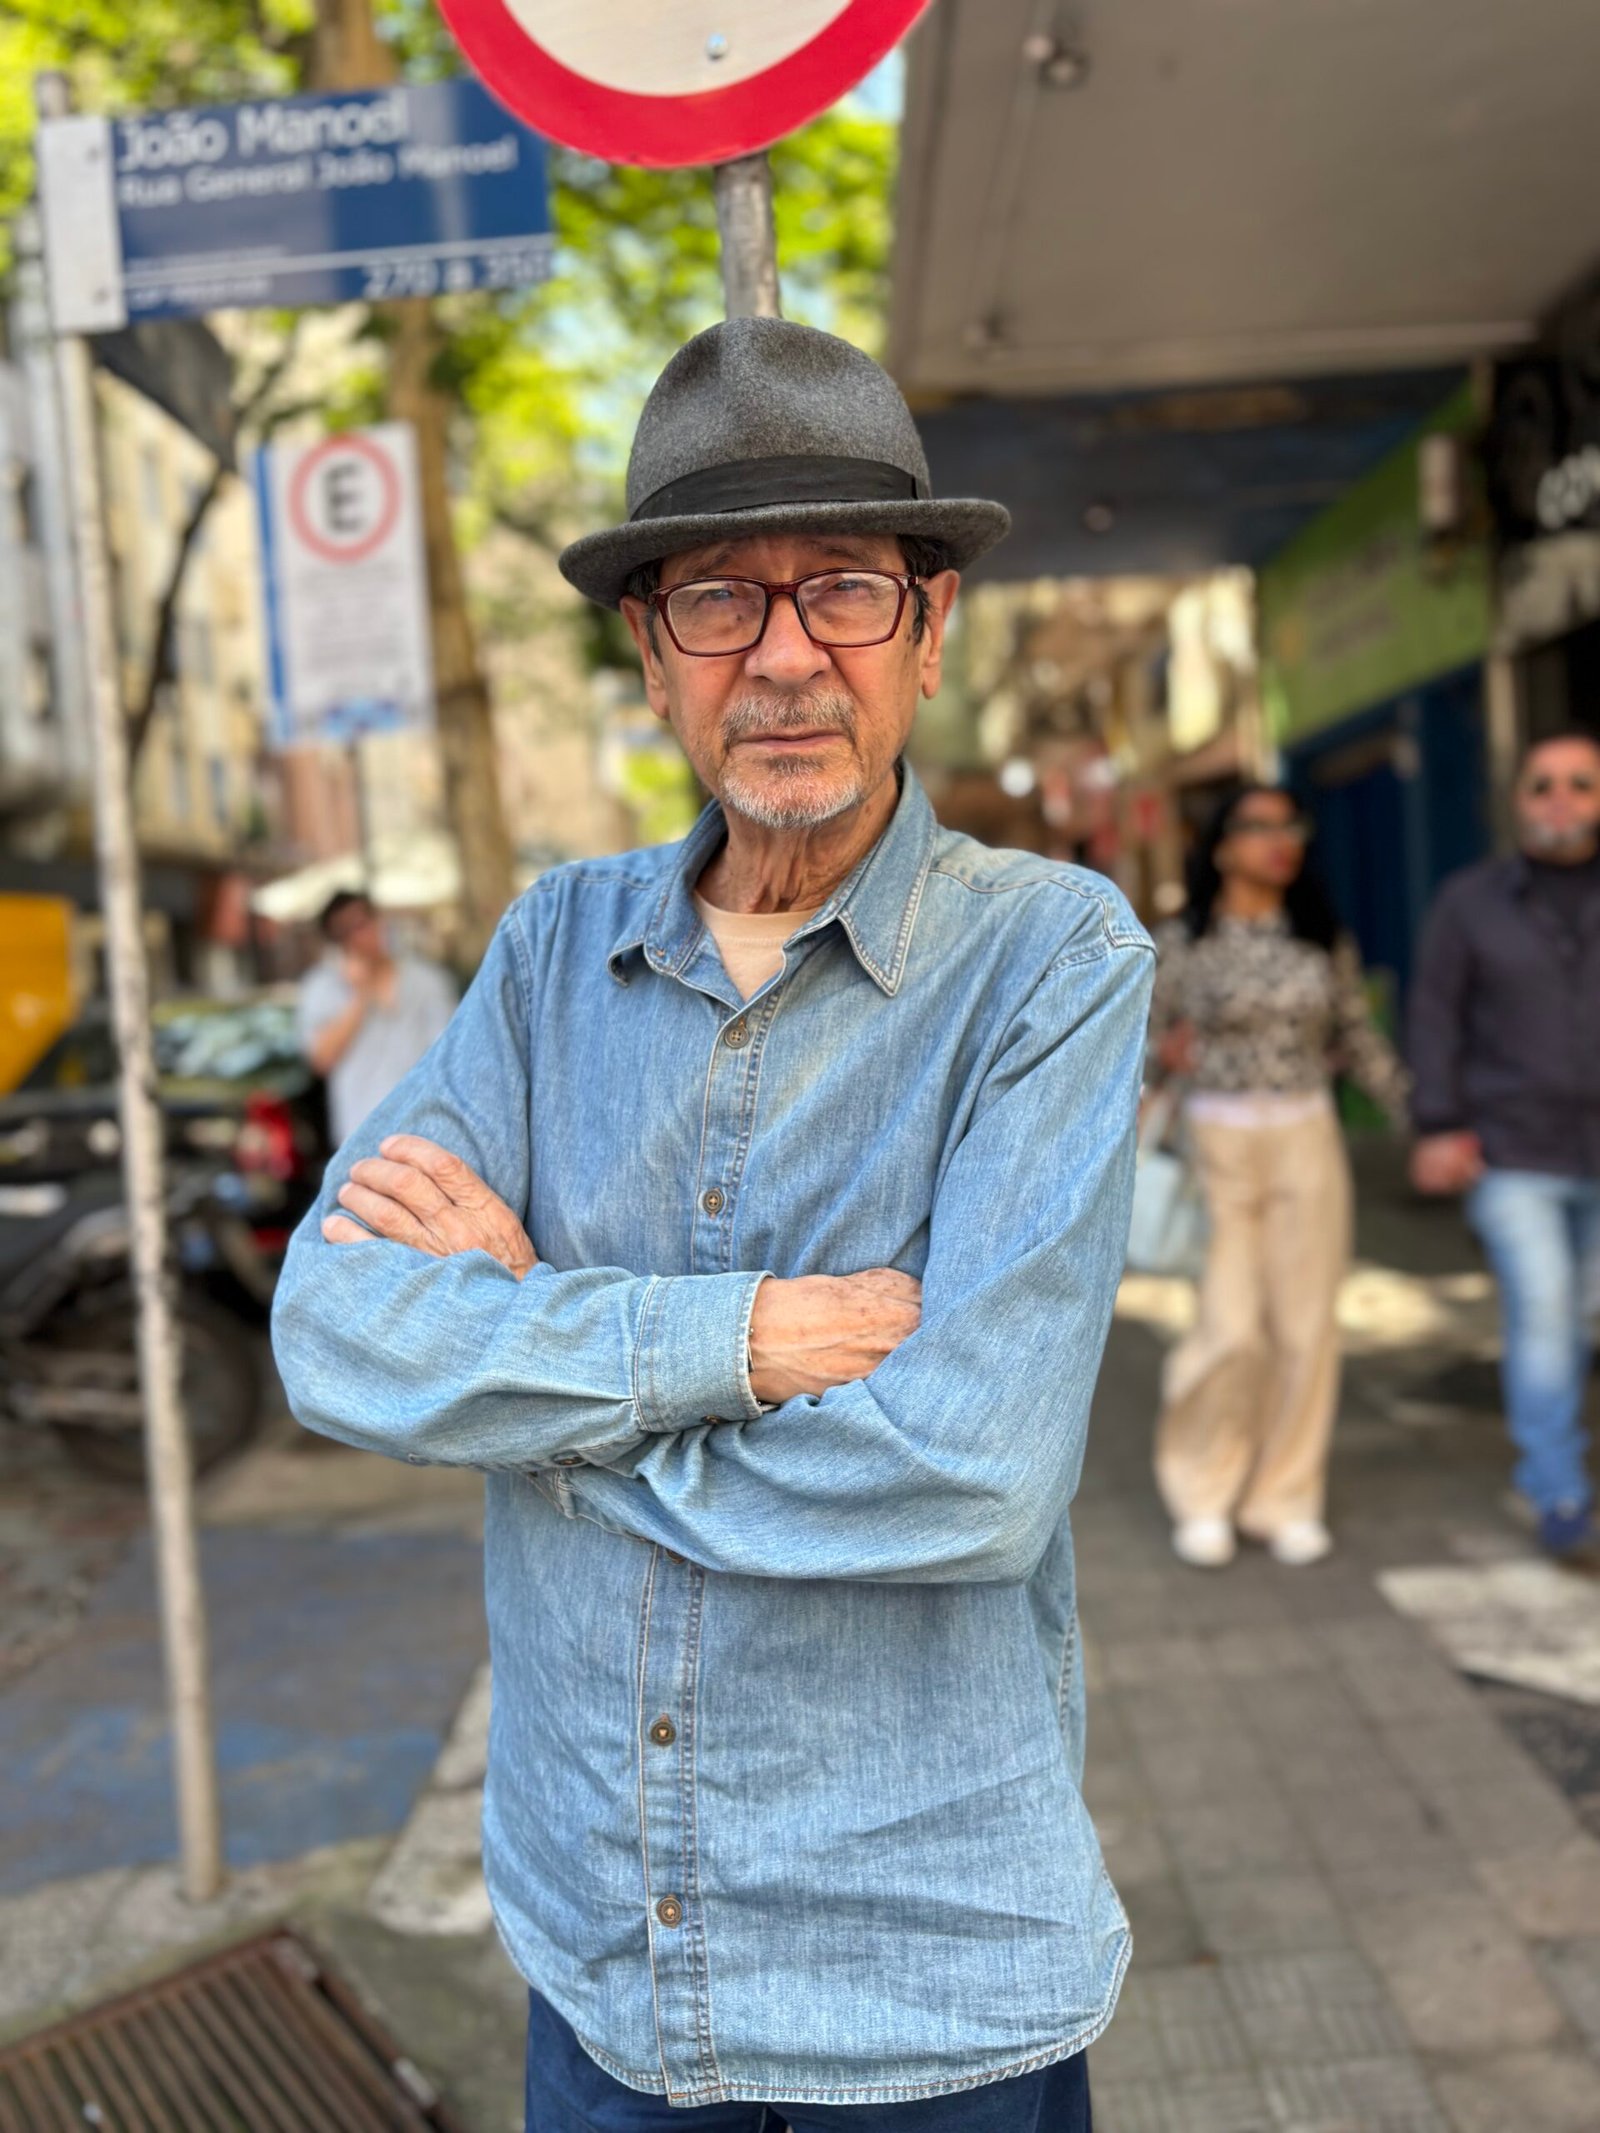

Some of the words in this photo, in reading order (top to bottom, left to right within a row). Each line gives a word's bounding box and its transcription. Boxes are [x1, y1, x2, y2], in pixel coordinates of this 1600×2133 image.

[119, 111, 228, 170] João
[237, 90, 407, 156] Manoel
[119, 174, 183, 207] Rua
[185, 156, 312, 202] General
[316, 150, 394, 189] João
[324, 461, 364, 533] E
